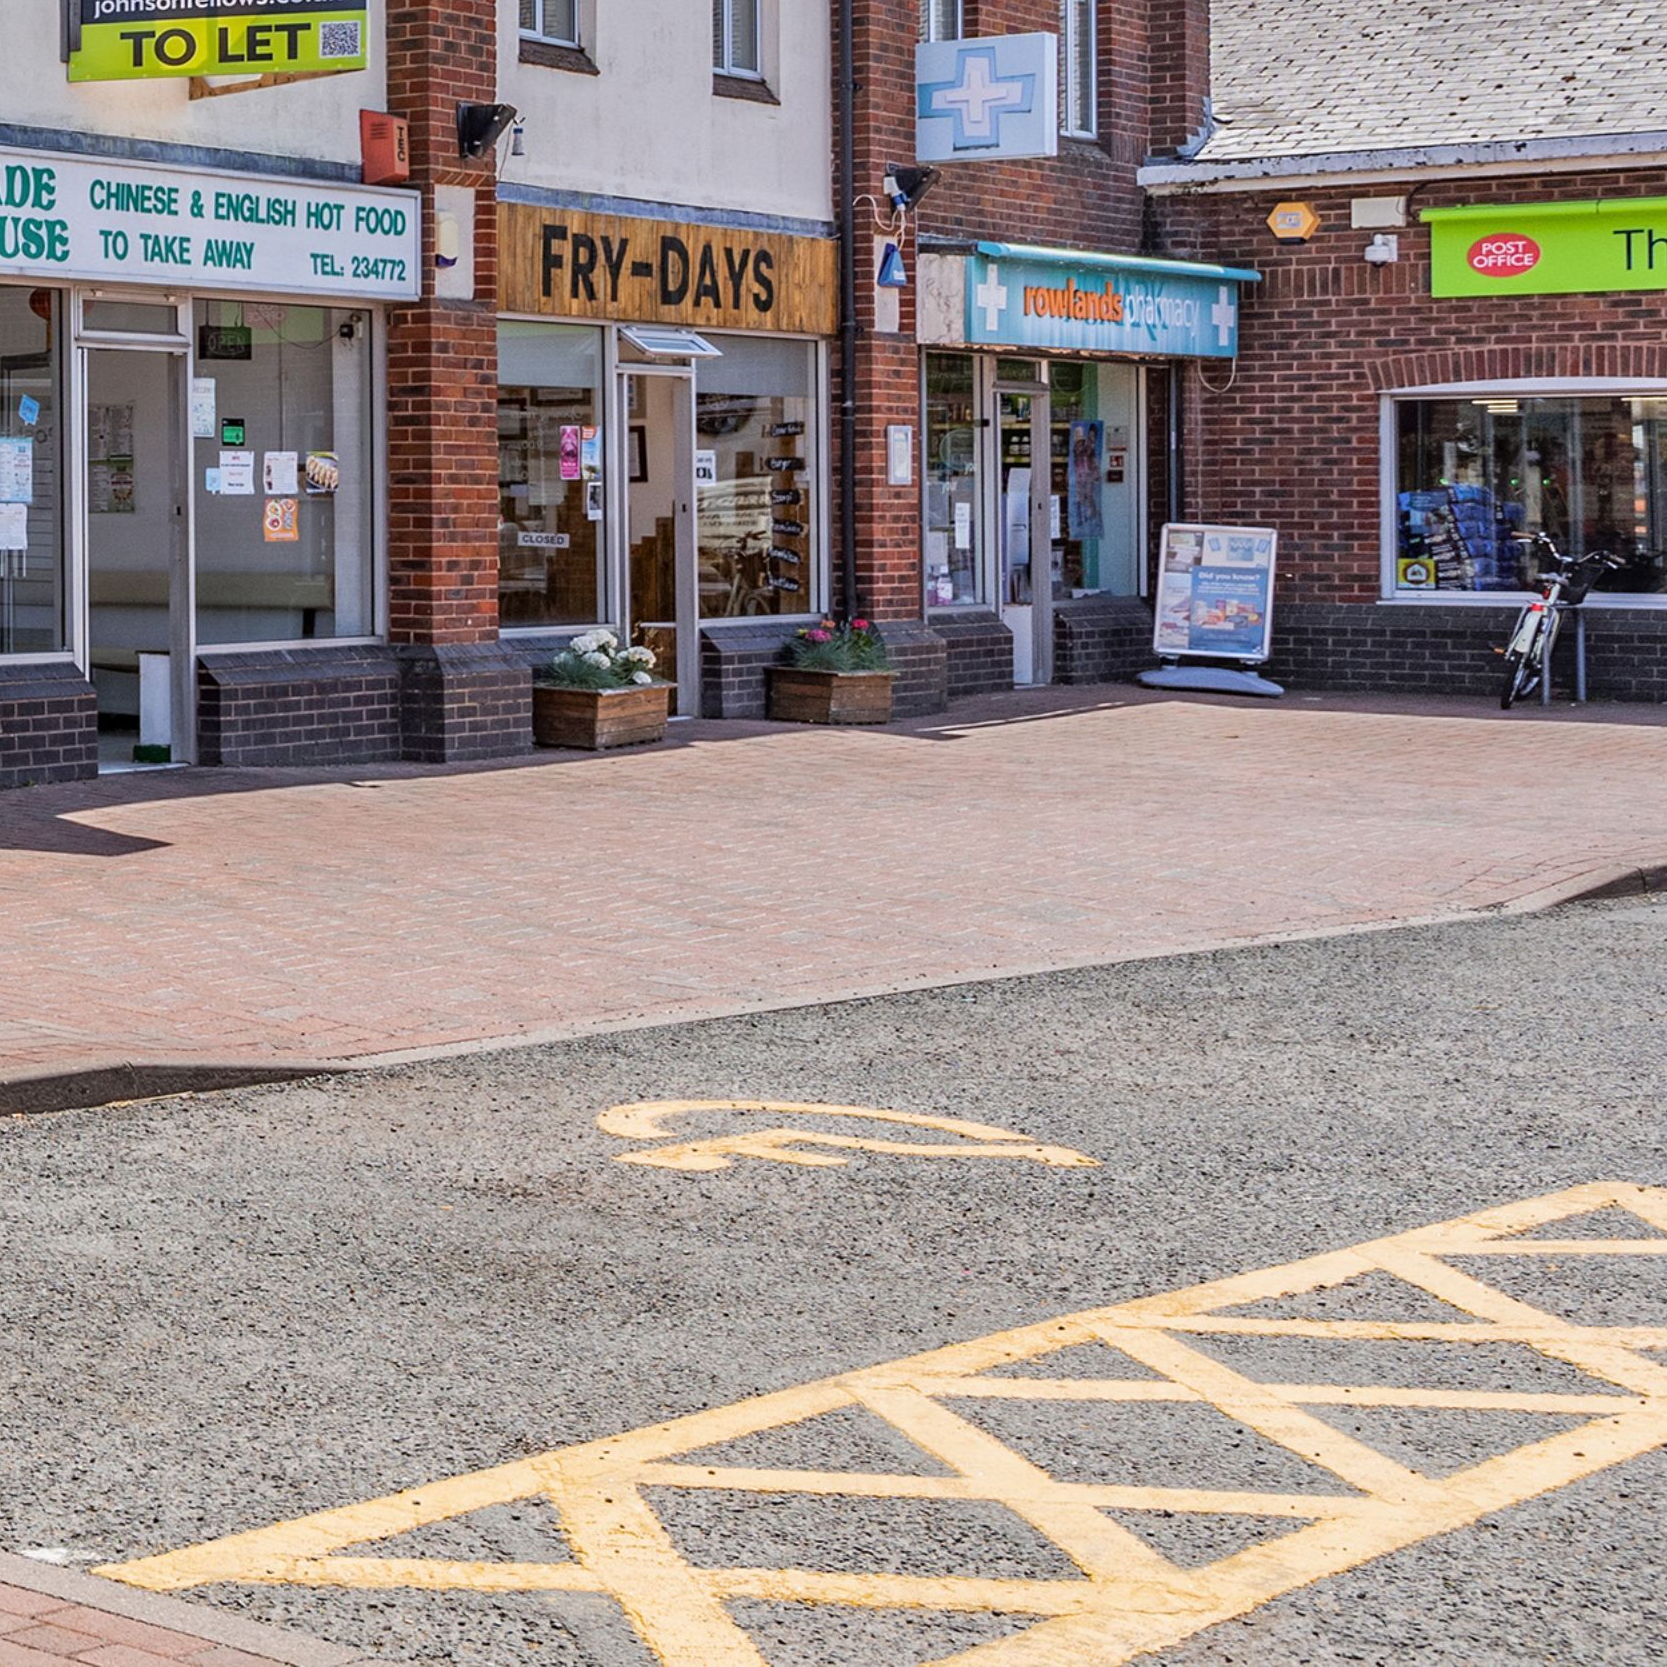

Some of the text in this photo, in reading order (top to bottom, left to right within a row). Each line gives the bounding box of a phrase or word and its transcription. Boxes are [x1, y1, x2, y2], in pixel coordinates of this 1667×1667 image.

[120, 23, 311, 67] TO LET
[90, 179, 407, 236] CHINESE & ENGLISH HOT FOOD
[99, 229, 255, 270] TO TAKE AWAY
[310, 253, 406, 281] TEL: 234772
[541, 224, 775, 313] FRY-DAYS
[1473, 253, 1534, 268] OFFICE
[1482, 241, 1526, 255] POST
[1024, 277, 1200, 333] rowlands pharmacy
[522, 534, 565, 545] CLOSED
